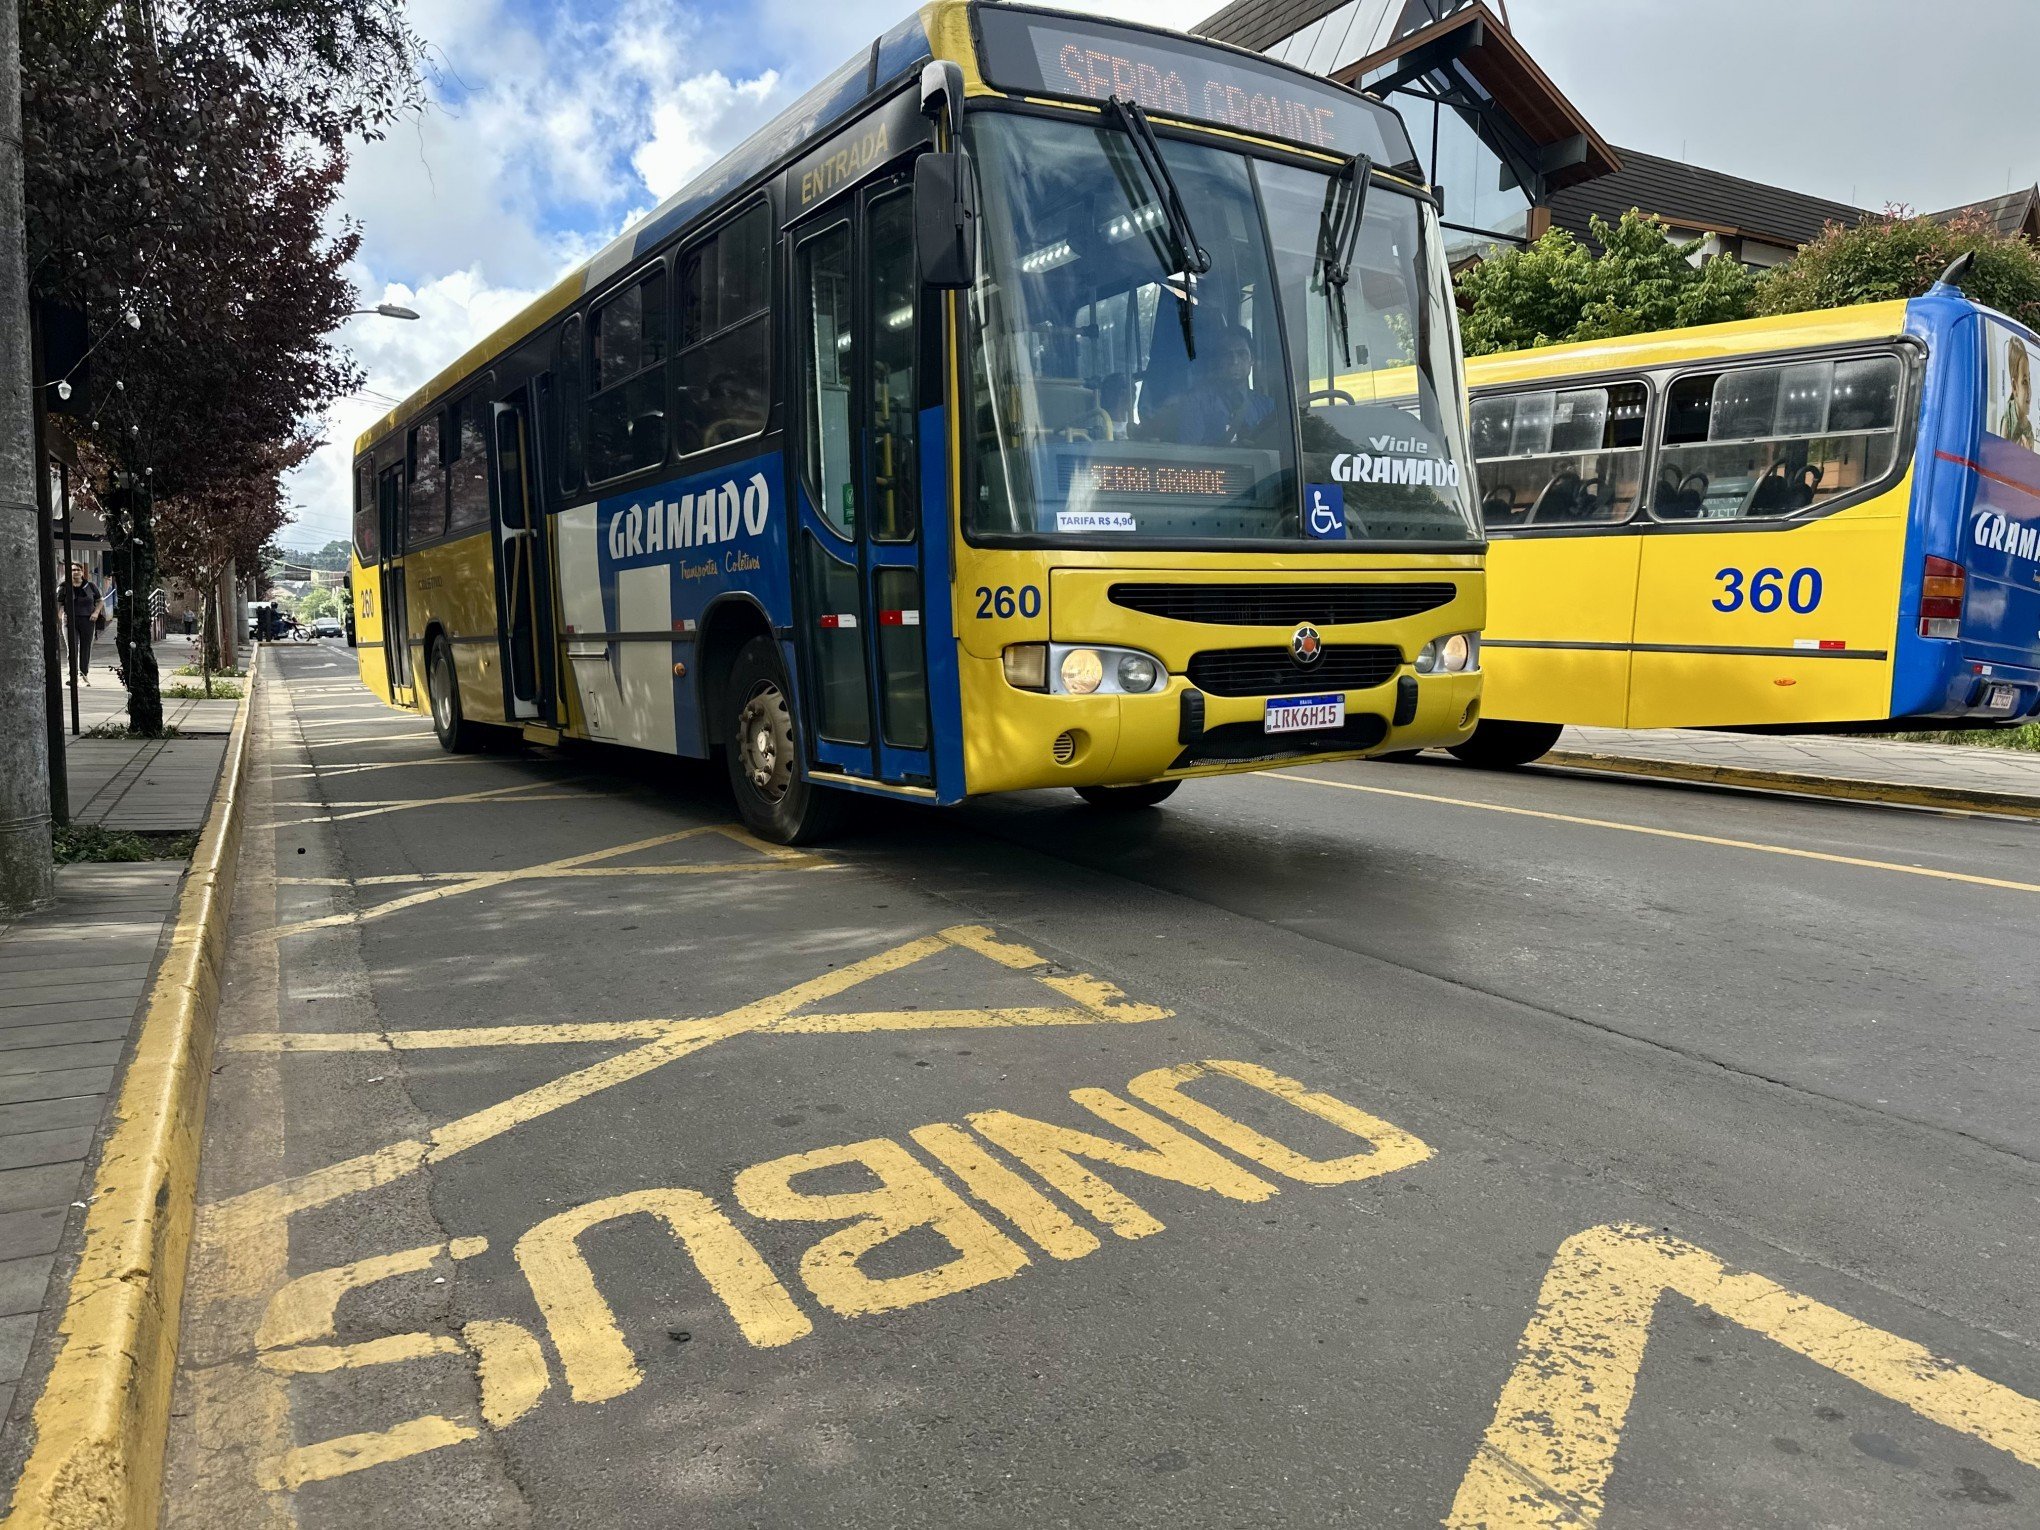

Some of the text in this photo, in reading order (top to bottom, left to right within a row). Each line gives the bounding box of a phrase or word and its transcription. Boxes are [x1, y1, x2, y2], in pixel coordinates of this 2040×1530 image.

[1060, 45, 1334, 147] SERRA GRANDE
[802, 122, 889, 205] ENTRADA
[1368, 435, 1428, 454] Viale
[1091, 465, 1227, 494] SERRA GRANDE
[1331, 452, 1460, 487] GRAMADO
[608, 472, 769, 560] GRAMADO
[1060, 516, 1134, 527] TARIFA R$ 4,90
[360, 588, 375, 619] 260
[975, 585, 1041, 619] 260
[1712, 567, 1823, 614] 360
[1272, 705, 1337, 729] IRK6H15
